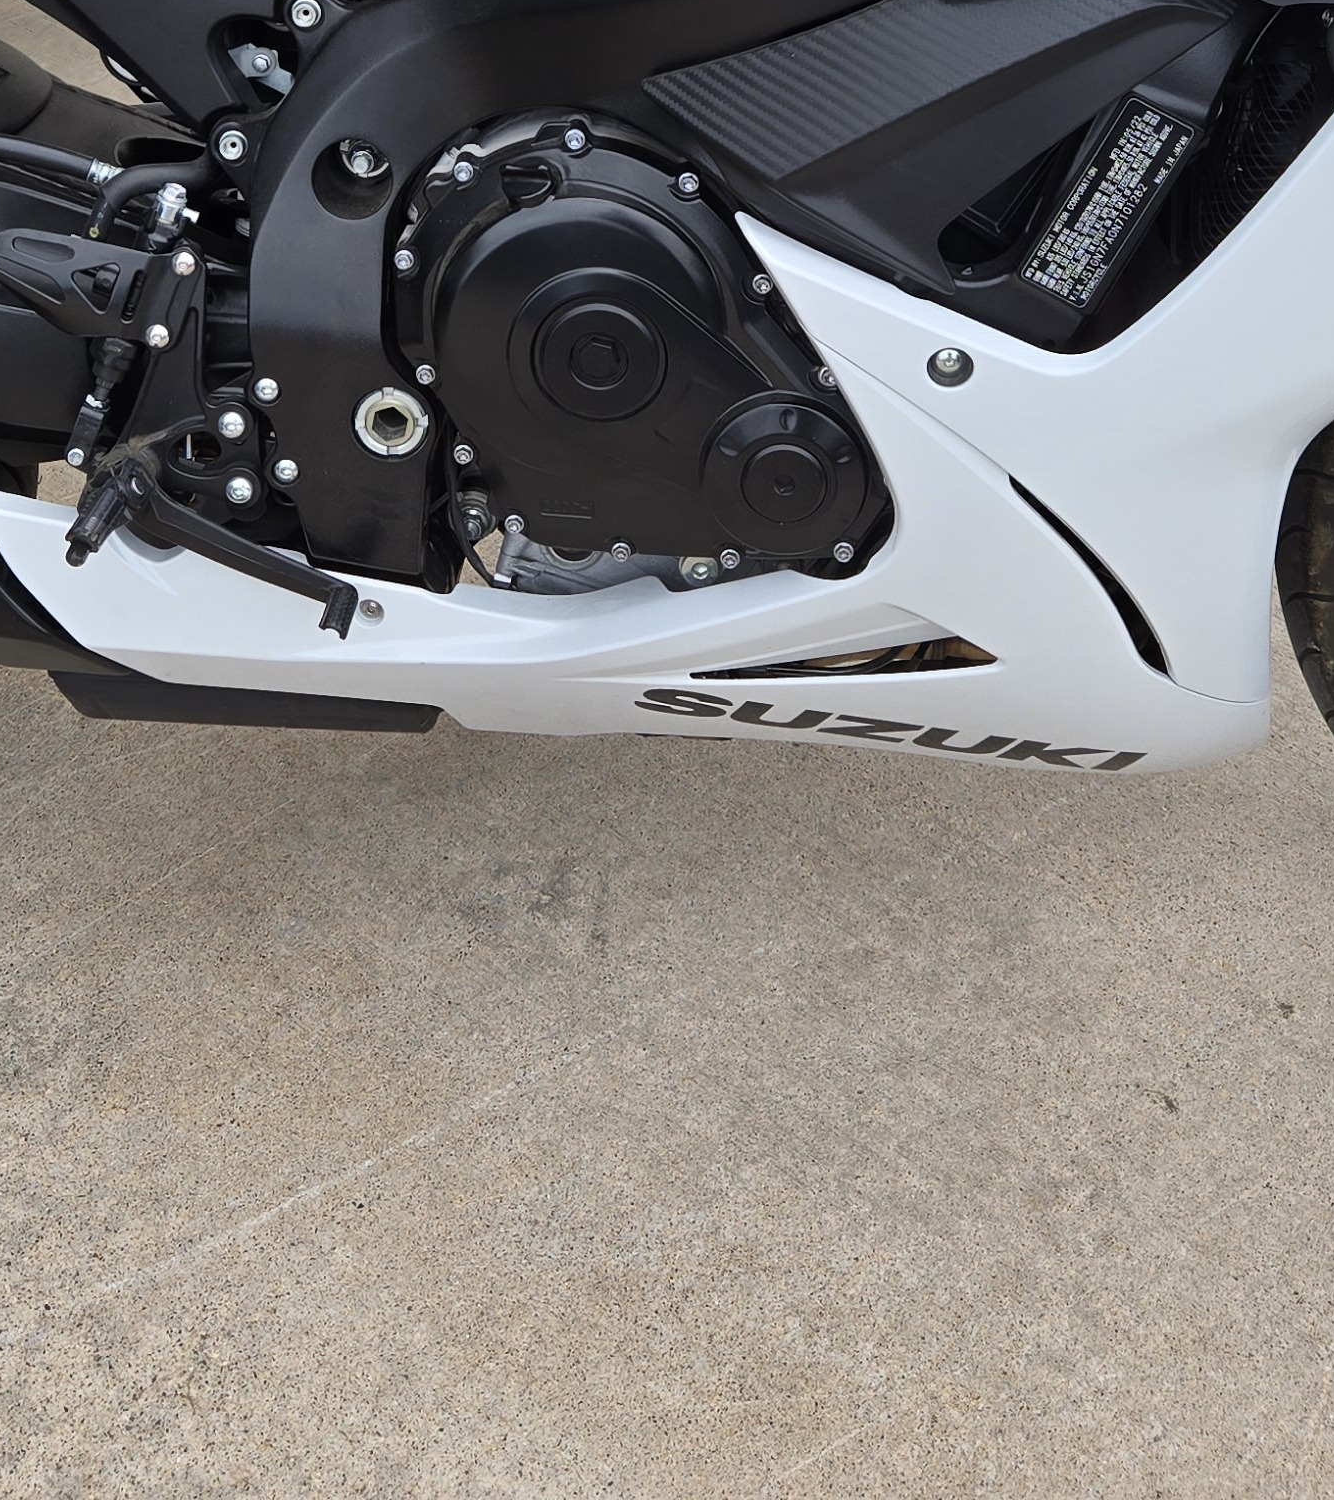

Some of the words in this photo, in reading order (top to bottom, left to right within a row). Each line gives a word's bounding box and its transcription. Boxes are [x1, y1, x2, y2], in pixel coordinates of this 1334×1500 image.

[1170, 134, 1189, 156] JAPAN
[1035, 232, 1056, 258] SUZUKI
[1052, 210, 1070, 233] MOTOR
[1065, 165, 1099, 211] CORPORATION
[633, 687, 1148, 772] SUZUKI
